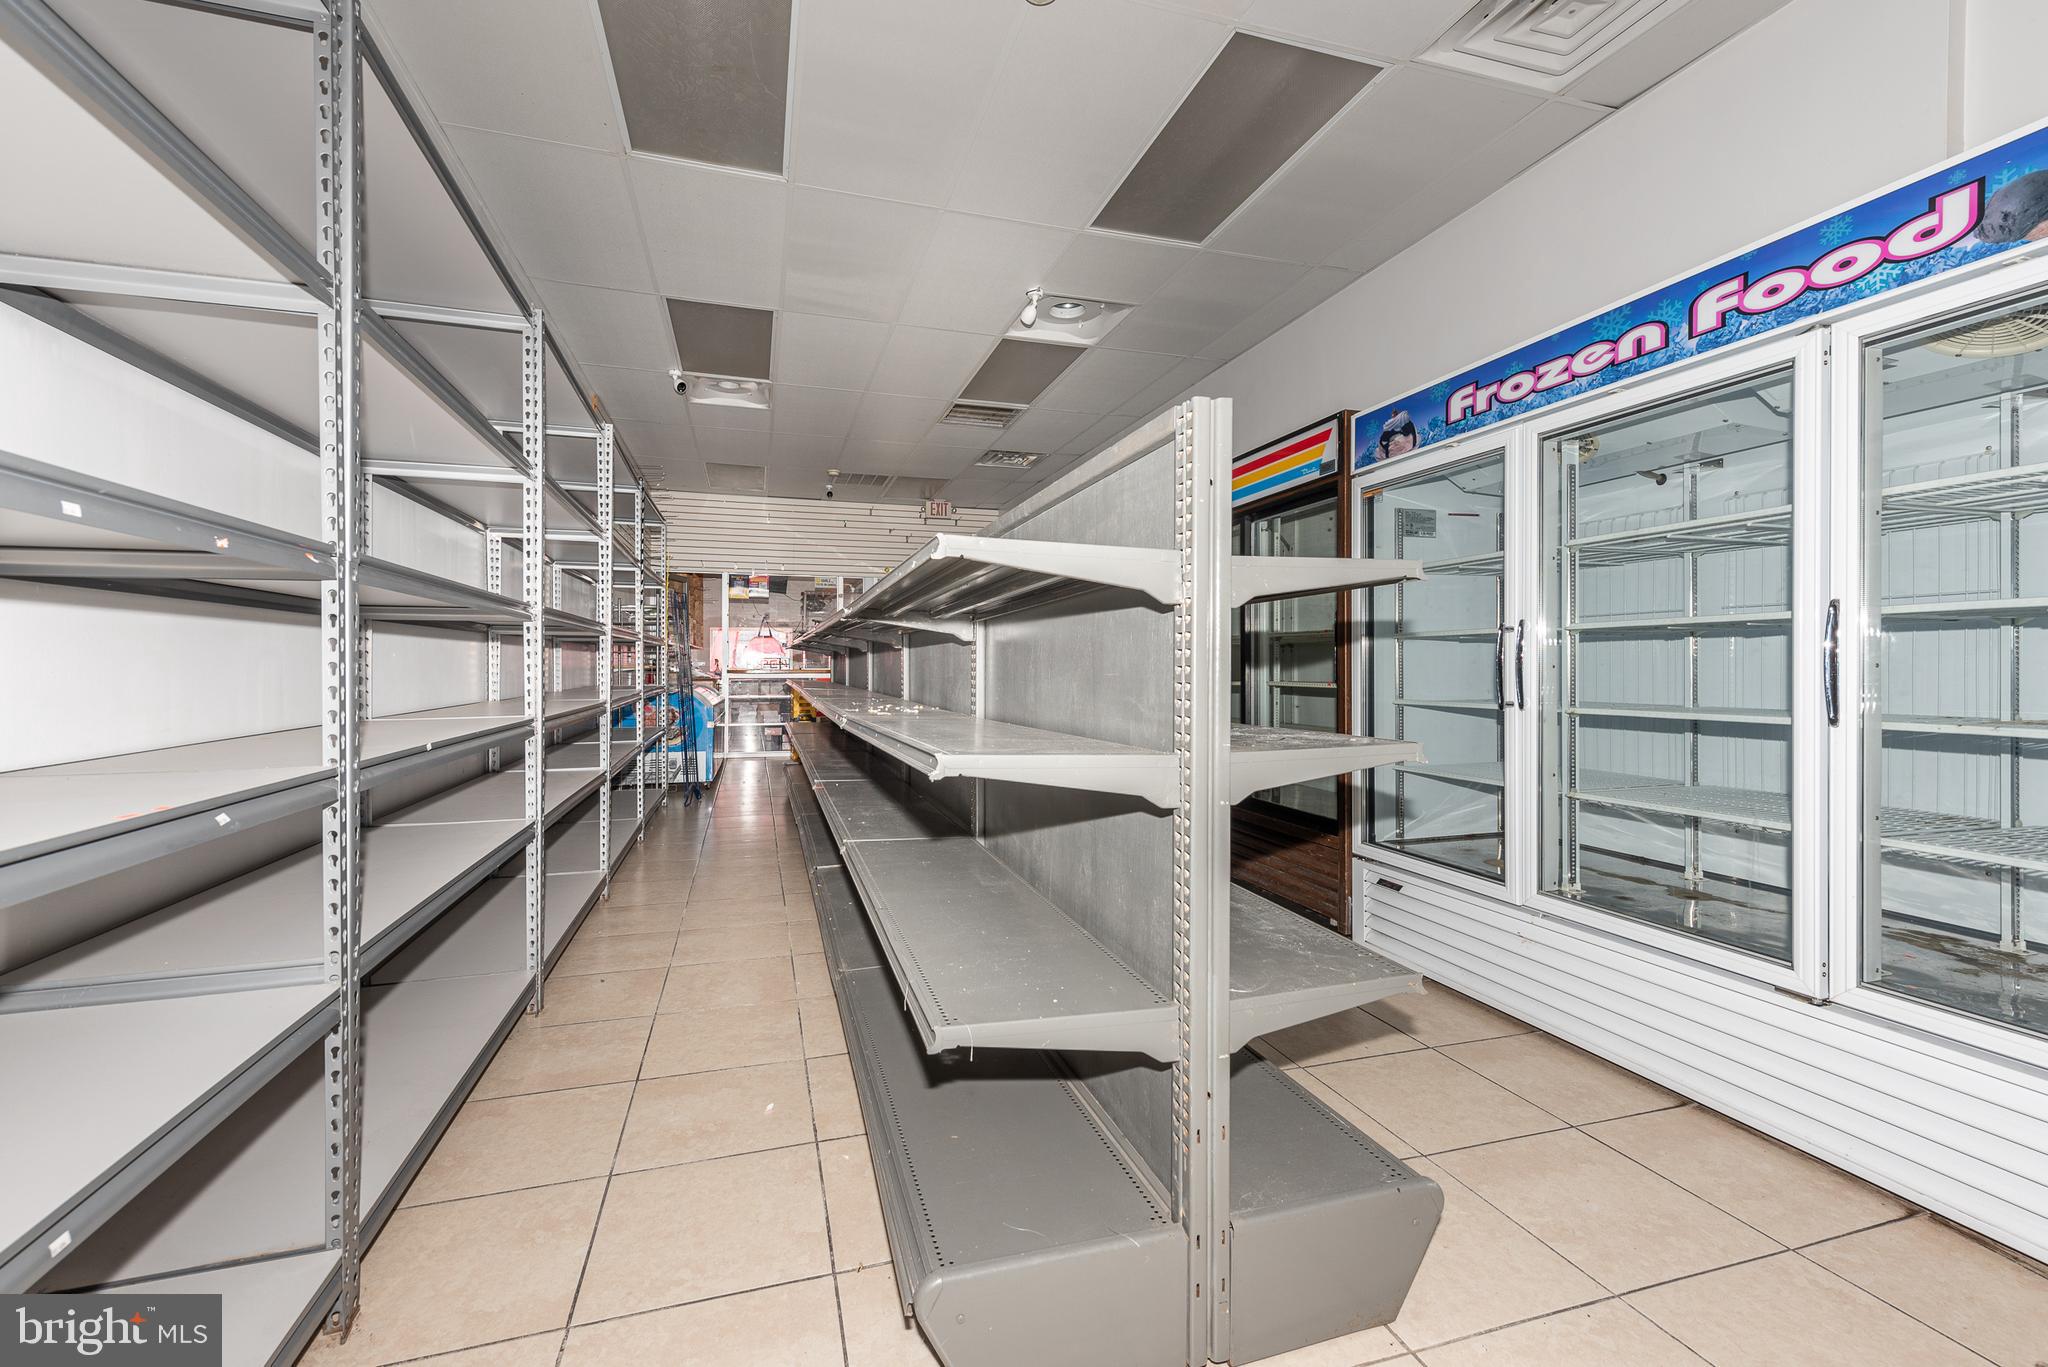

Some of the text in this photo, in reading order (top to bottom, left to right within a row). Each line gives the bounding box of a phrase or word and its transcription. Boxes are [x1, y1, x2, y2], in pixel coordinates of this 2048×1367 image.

[1446, 176, 1986, 425] Frozen Food
[930, 502, 949, 517] EXIT
